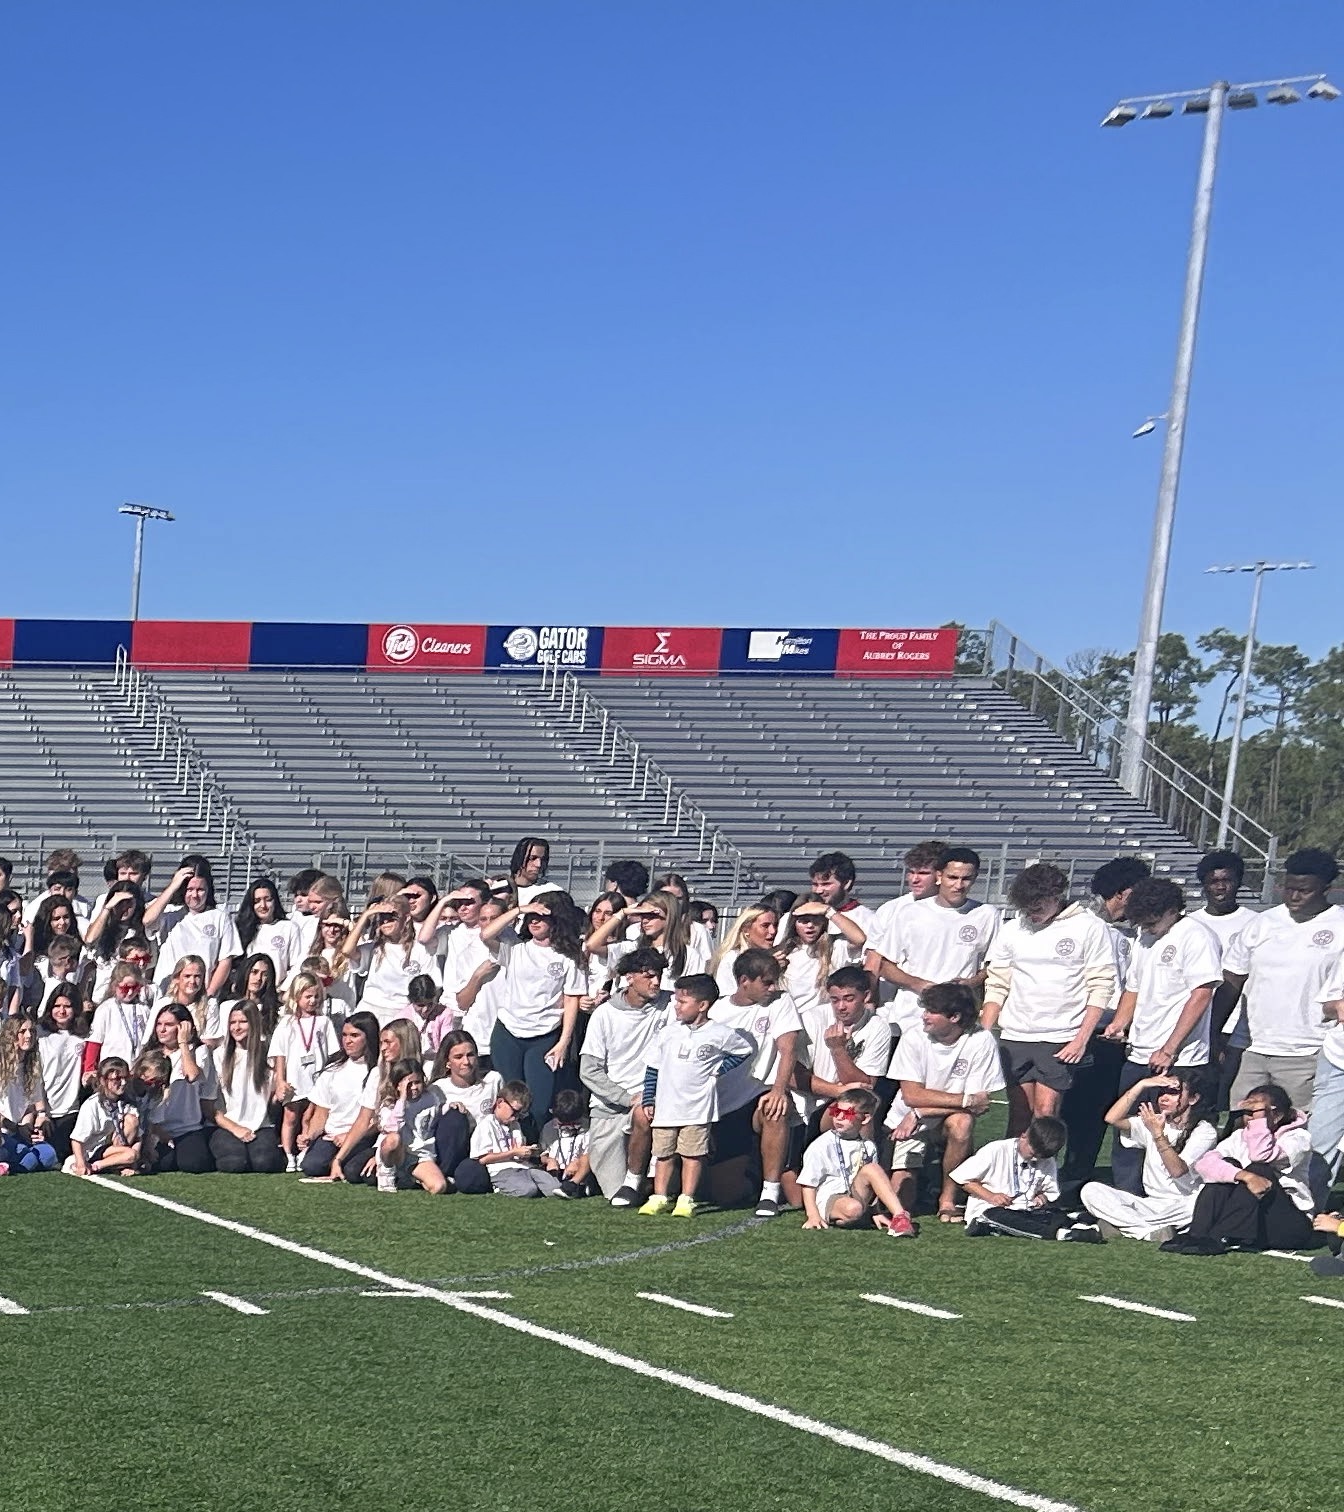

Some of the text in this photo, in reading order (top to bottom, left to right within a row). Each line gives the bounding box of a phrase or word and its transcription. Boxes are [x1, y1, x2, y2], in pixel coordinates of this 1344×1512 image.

[385, 634, 472, 656] Tide Cleaners
[539, 627, 588, 650] GATOR
[537, 650, 586, 663] GOLF CARS
[632, 653, 686, 666] SIGMA
